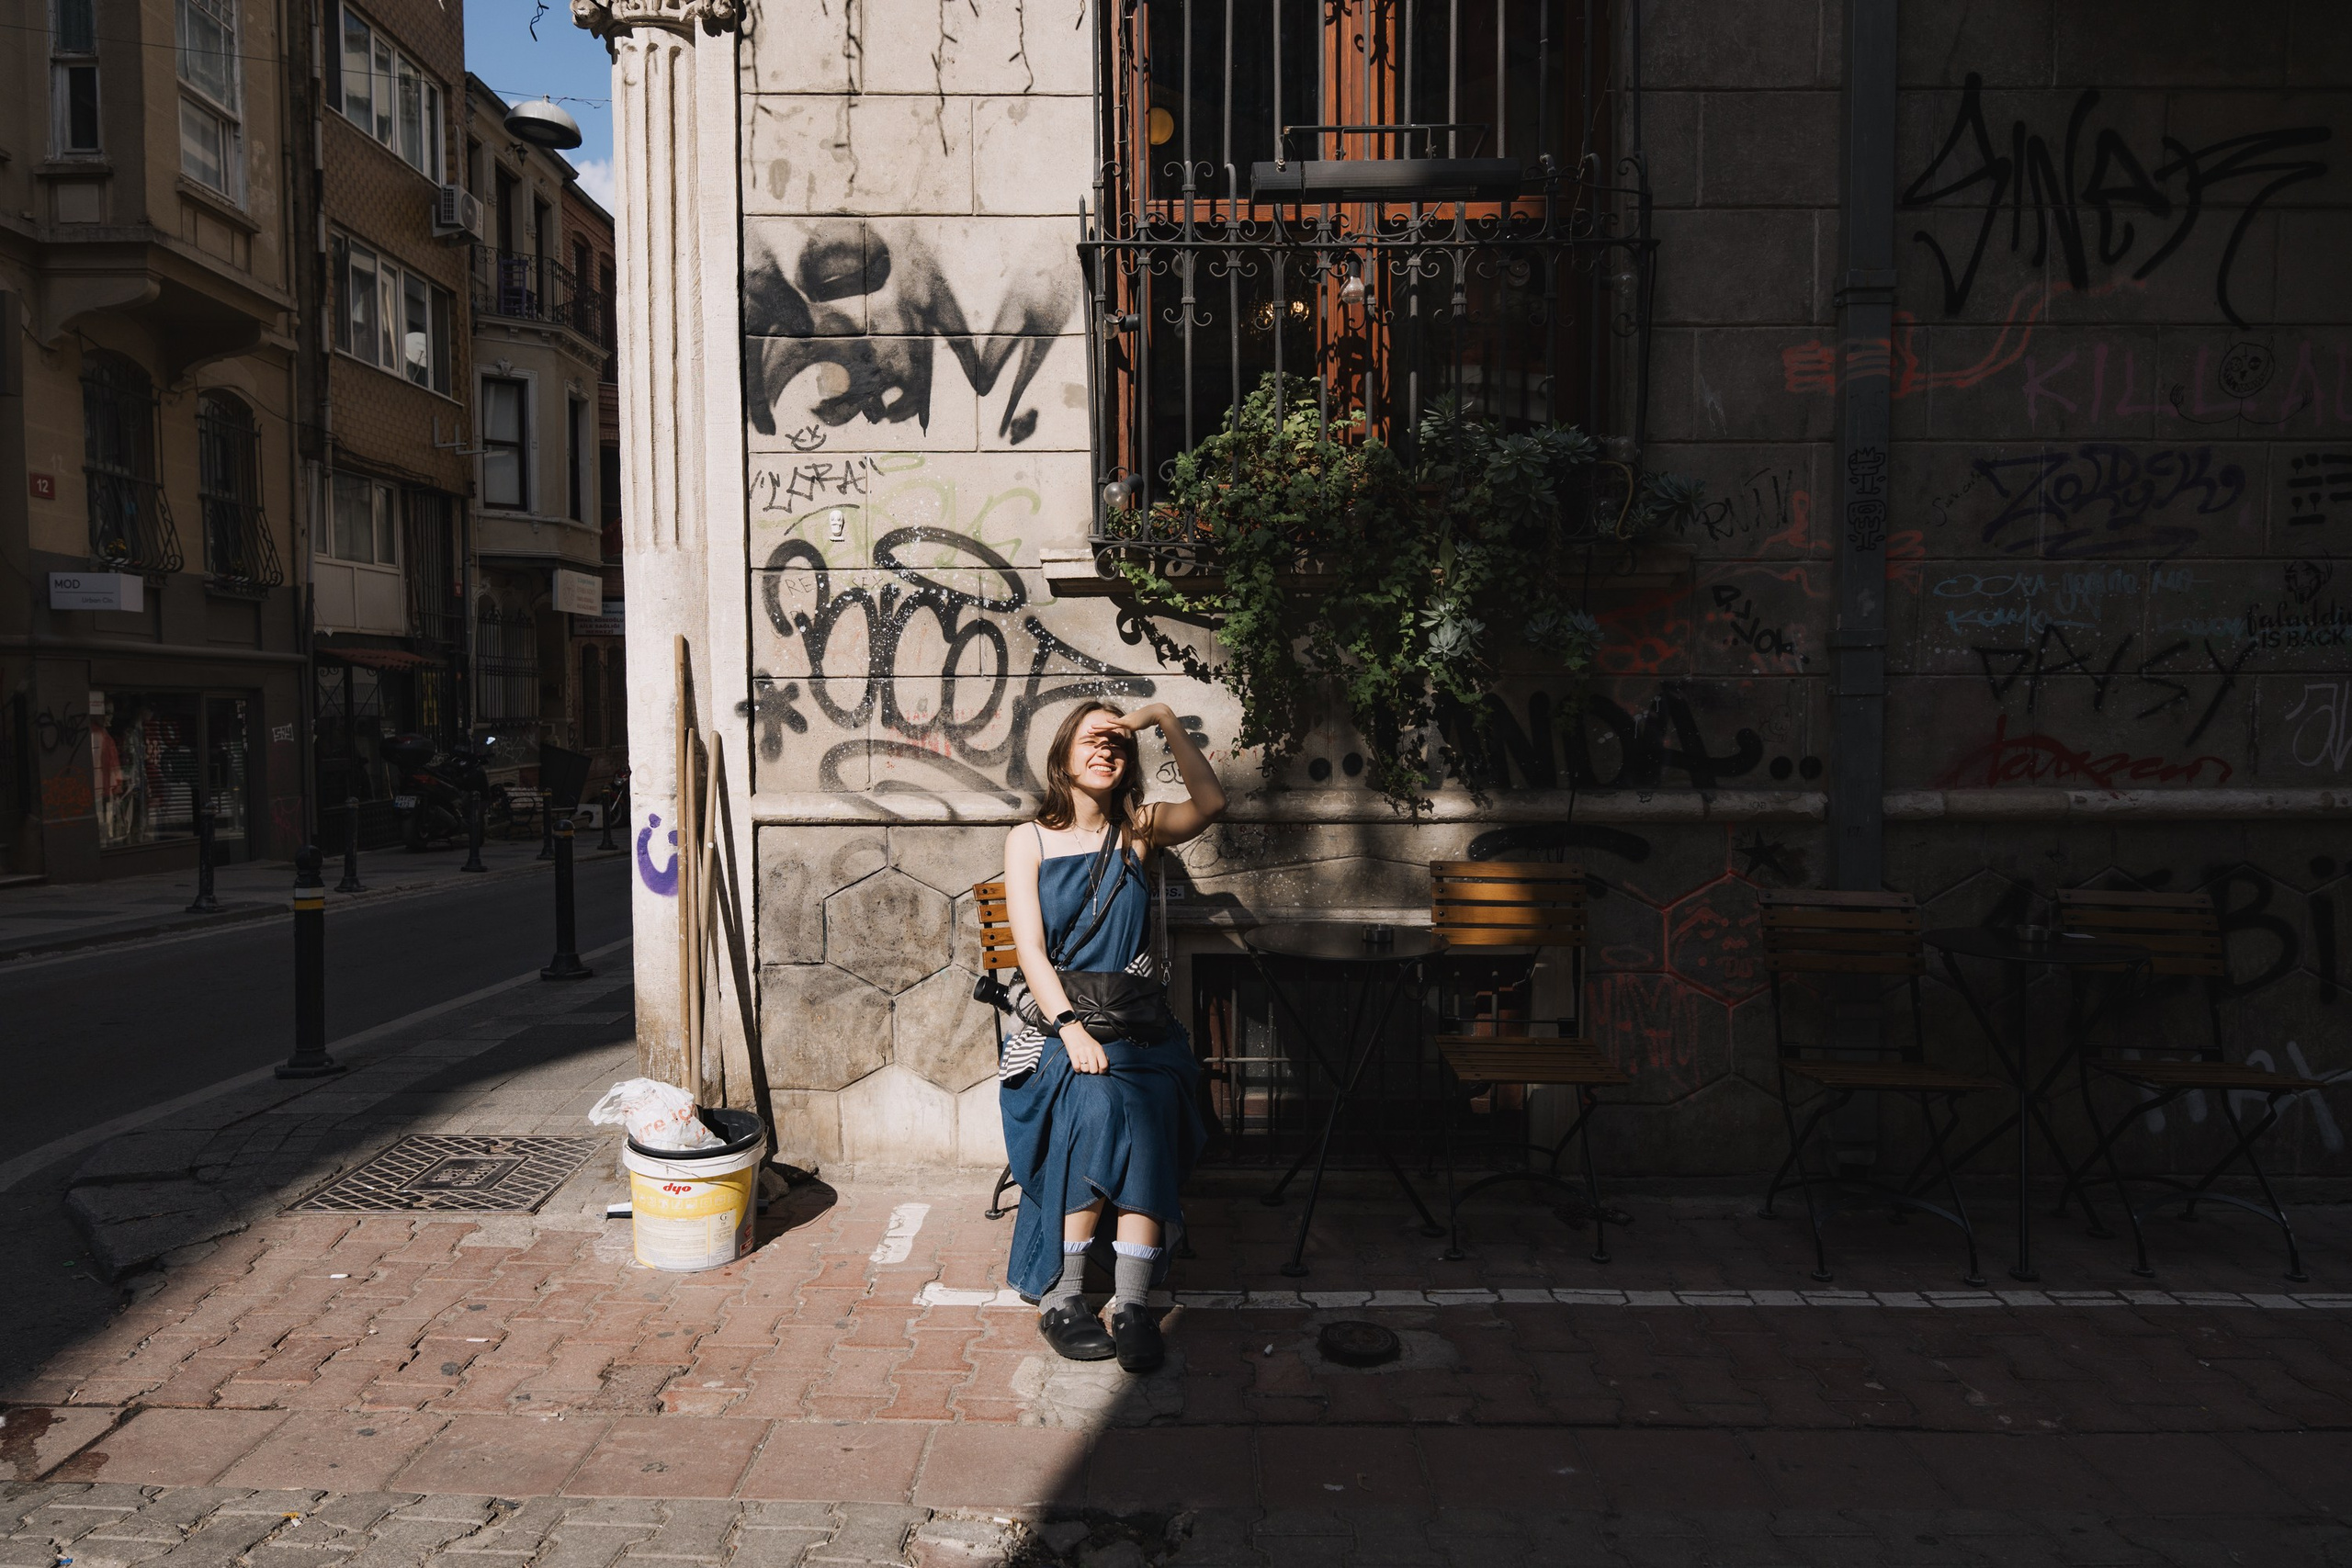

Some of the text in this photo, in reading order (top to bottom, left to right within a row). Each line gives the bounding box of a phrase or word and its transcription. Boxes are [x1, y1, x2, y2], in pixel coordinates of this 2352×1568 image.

[37, 479, 49, 493] 12
[54, 579, 81, 589] MOD
[2261, 630, 2281, 648] IS
[2287, 628, 2346, 648] BACK
[662, 1183, 692, 1195] dyo
